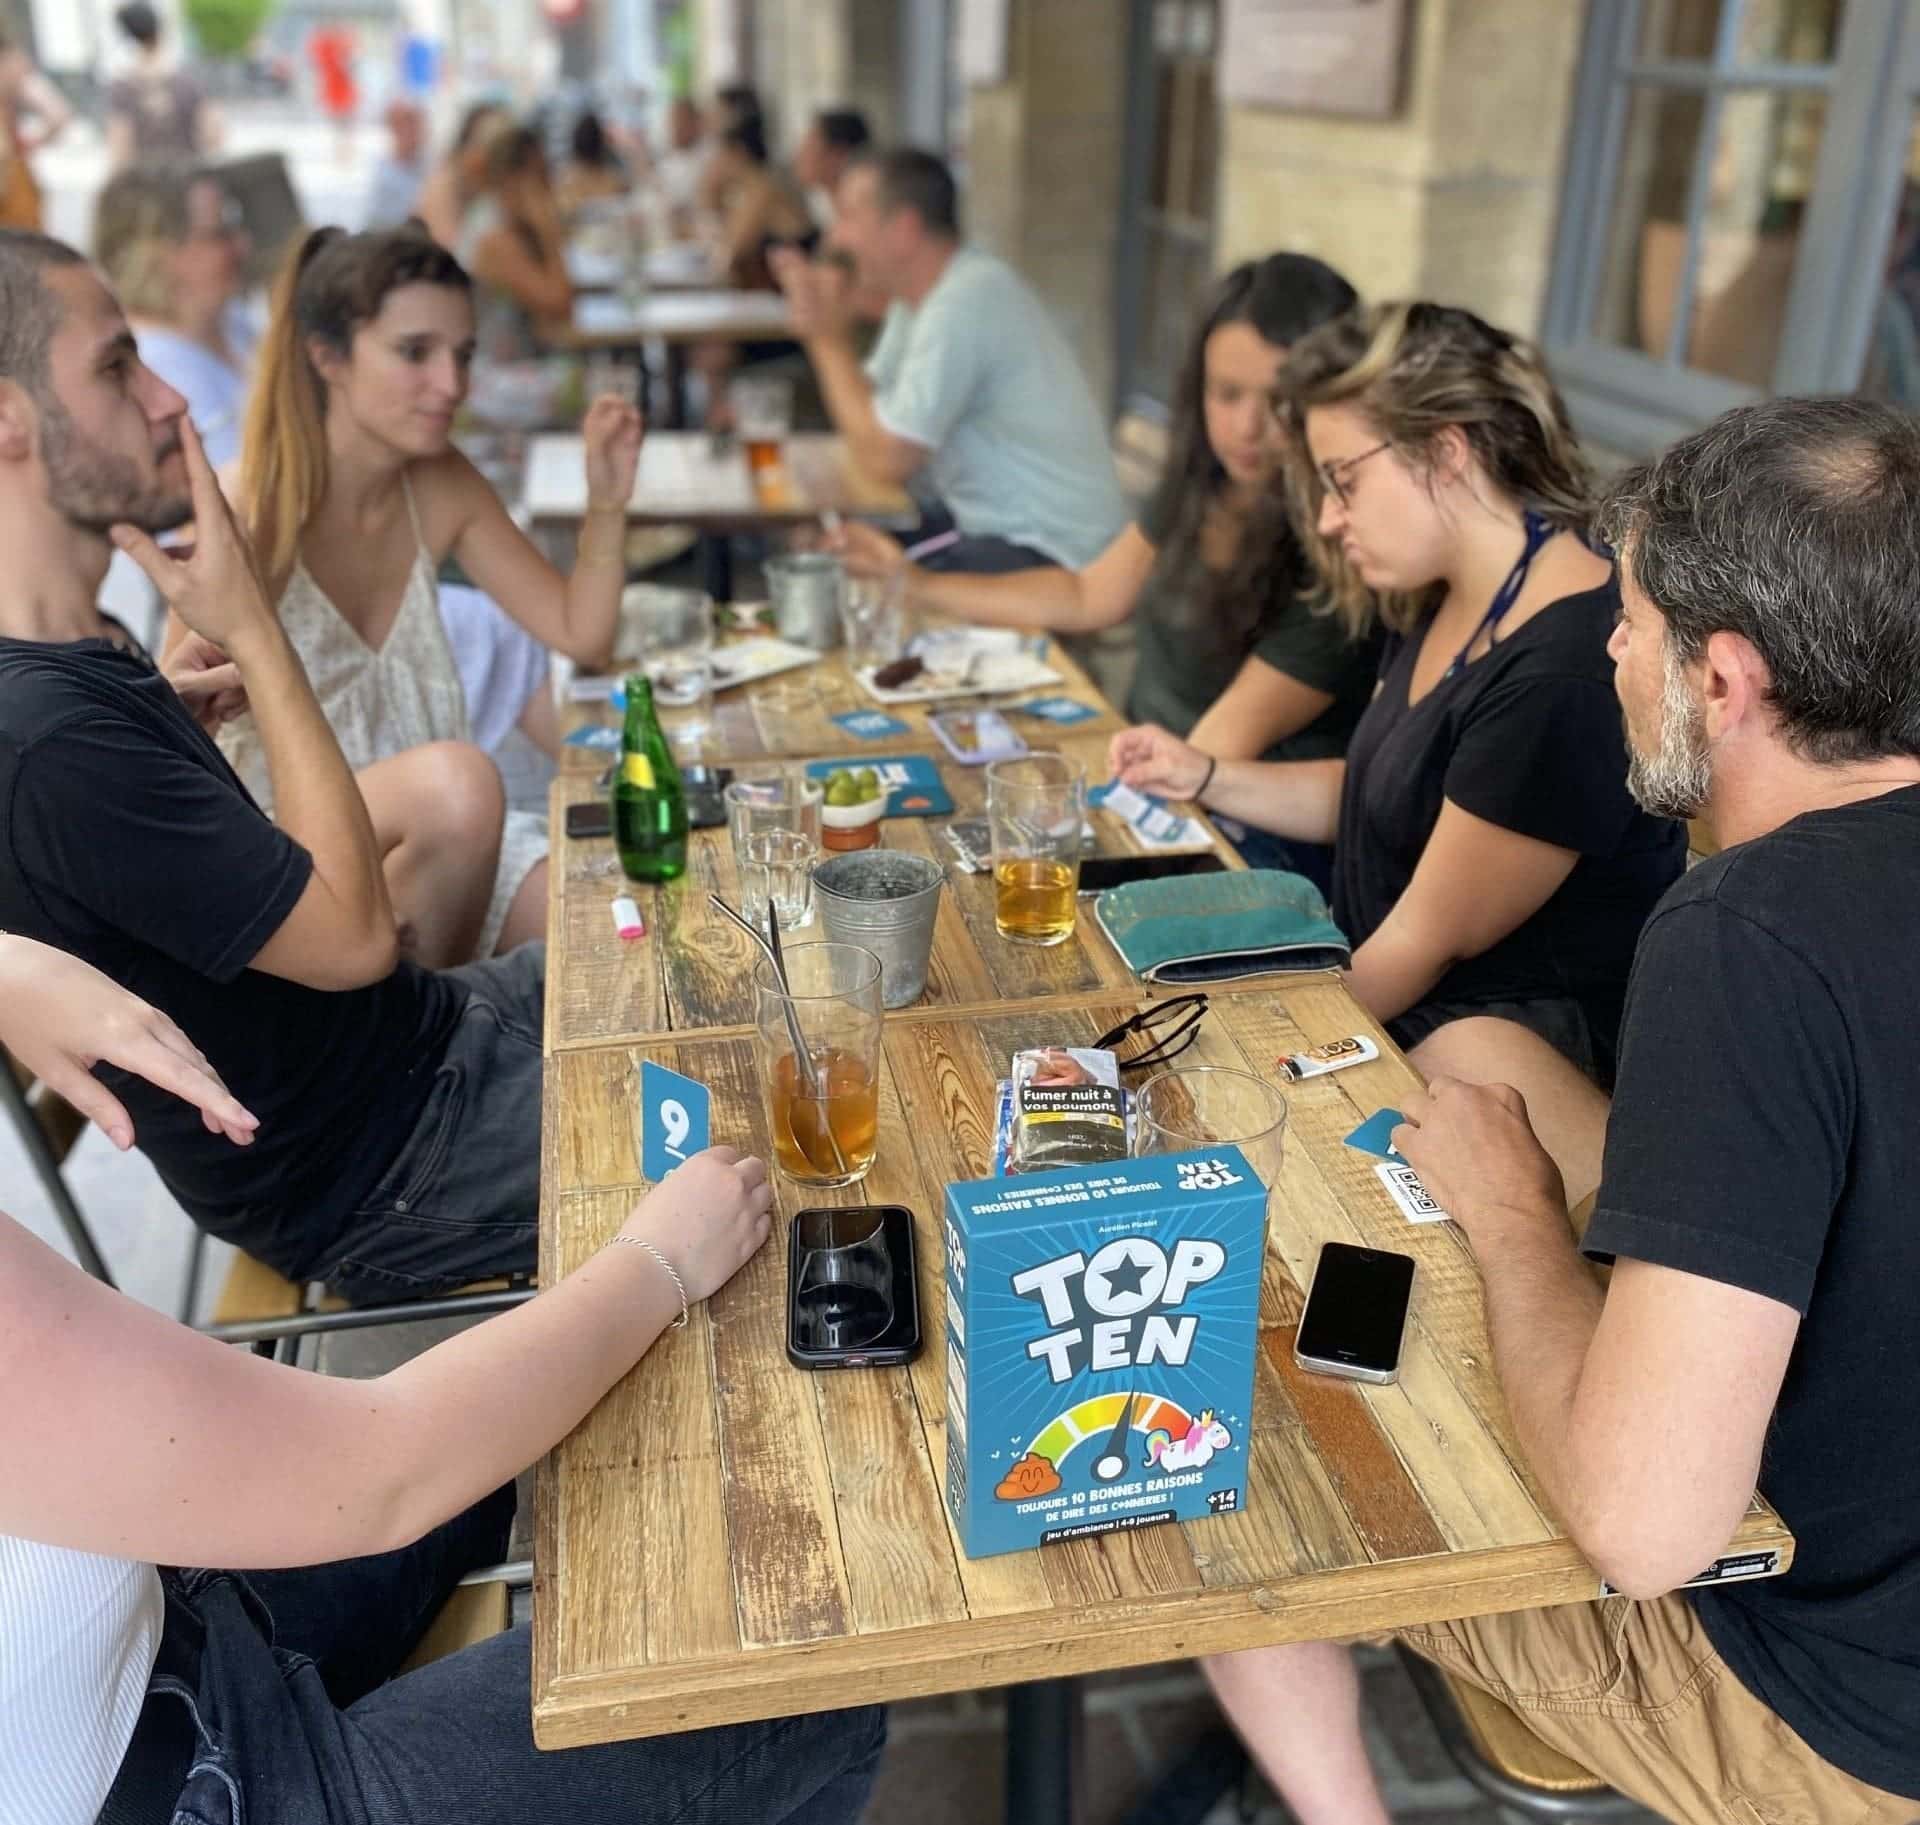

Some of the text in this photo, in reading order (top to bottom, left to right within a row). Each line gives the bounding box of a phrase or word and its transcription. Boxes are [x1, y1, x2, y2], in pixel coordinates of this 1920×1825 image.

[1023, 1088, 1112, 1101] Fumer nuit à
[1024, 1102, 1117, 1113] vos poumons
[1176, 1158, 1233, 1176] TEN
[1064, 1181, 1084, 1192] DES
[1112, 1176, 1128, 1186] DE
[1178, 1171, 1244, 1191] TOP
[971, 1181, 1163, 1216] TOUJOURS 10 BONNES RAISONS
[1012, 1237, 1225, 1327] TOP
[1028, 1316, 1199, 1384] TEN
[1016, 1473, 1204, 1515] TOUJOURS 10 BONNES RAISONS
[1207, 1489, 1236, 1504] +14
[1046, 1511, 1060, 1523] DE
[1061, 1507, 1085, 1521] DIRE
[1089, 1503, 1108, 1516] DES
[1219, 1502, 1235, 1511] ans
[1046, 1531, 1062, 1542] jeu
[1062, 1521, 1114, 1537] d'ambiance
[1136, 1512, 1170, 1526] joueurs
